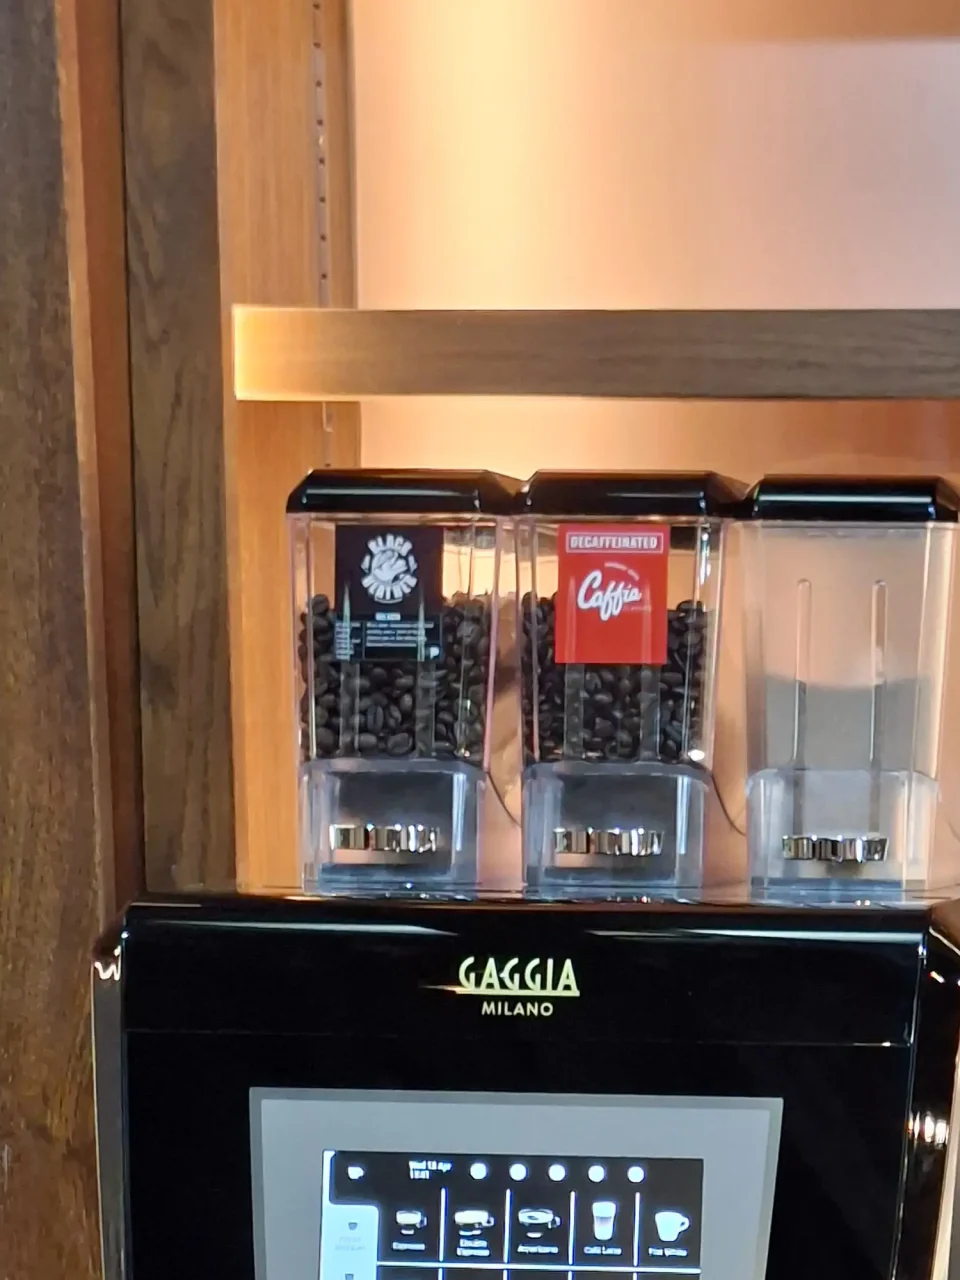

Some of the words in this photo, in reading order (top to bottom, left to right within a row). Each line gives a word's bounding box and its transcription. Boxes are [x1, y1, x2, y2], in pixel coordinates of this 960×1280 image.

[570, 536, 658, 549] DECAFFEINATED
[458, 956, 580, 995] GAGGIA
[481, 1001, 554, 1017] MILANO
